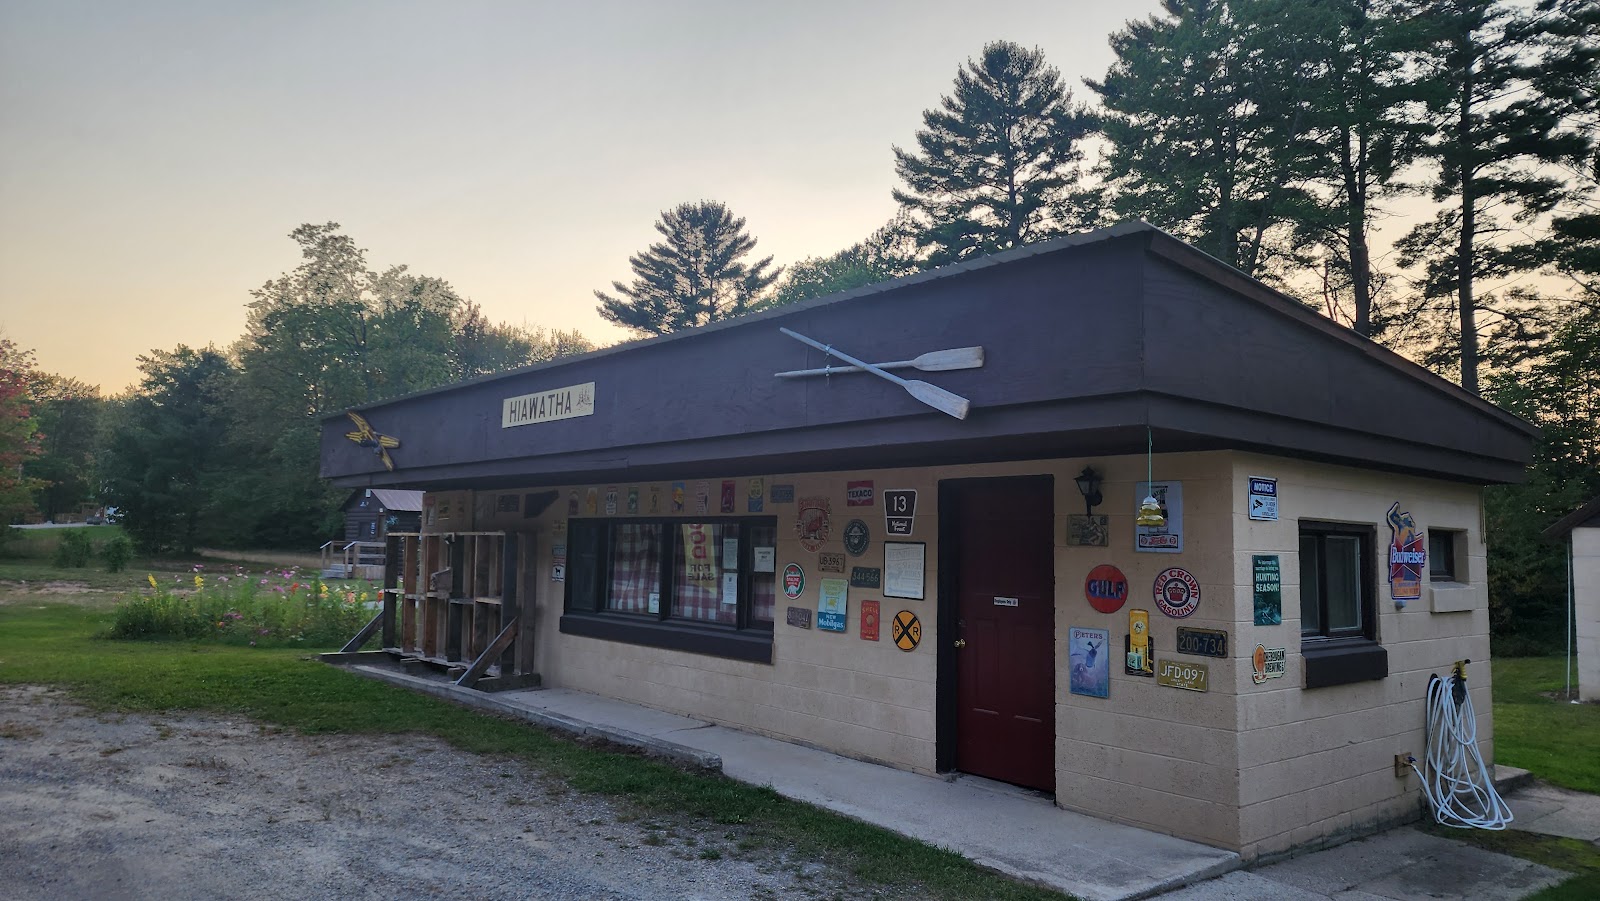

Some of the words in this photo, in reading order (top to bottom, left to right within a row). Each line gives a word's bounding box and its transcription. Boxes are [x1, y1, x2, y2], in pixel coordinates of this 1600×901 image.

[509, 390, 572, 423] HIAWATHA
[1253, 482, 1274, 493] NOTICE
[848, 489, 873, 499] TEXACO
[893, 495, 907, 512] 13
[1391, 546, 1425, 564] Budweiser
[1255, 572, 1279, 582] HUNTING
[1087, 579, 1126, 599] GULF
[1156, 574, 1167, 595] RED
[1168, 569, 1198, 599] CROWN
[1255, 582, 1280, 592] SEASON!
[861, 606, 879, 615] SHELL
[1158, 599, 1195, 616] GASOLINE
[818, 617, 844, 630] Mobilgas
[894, 625, 900, 634] R
[912, 627, 919, 636] R
[1073, 629, 1104, 640] PETERS
